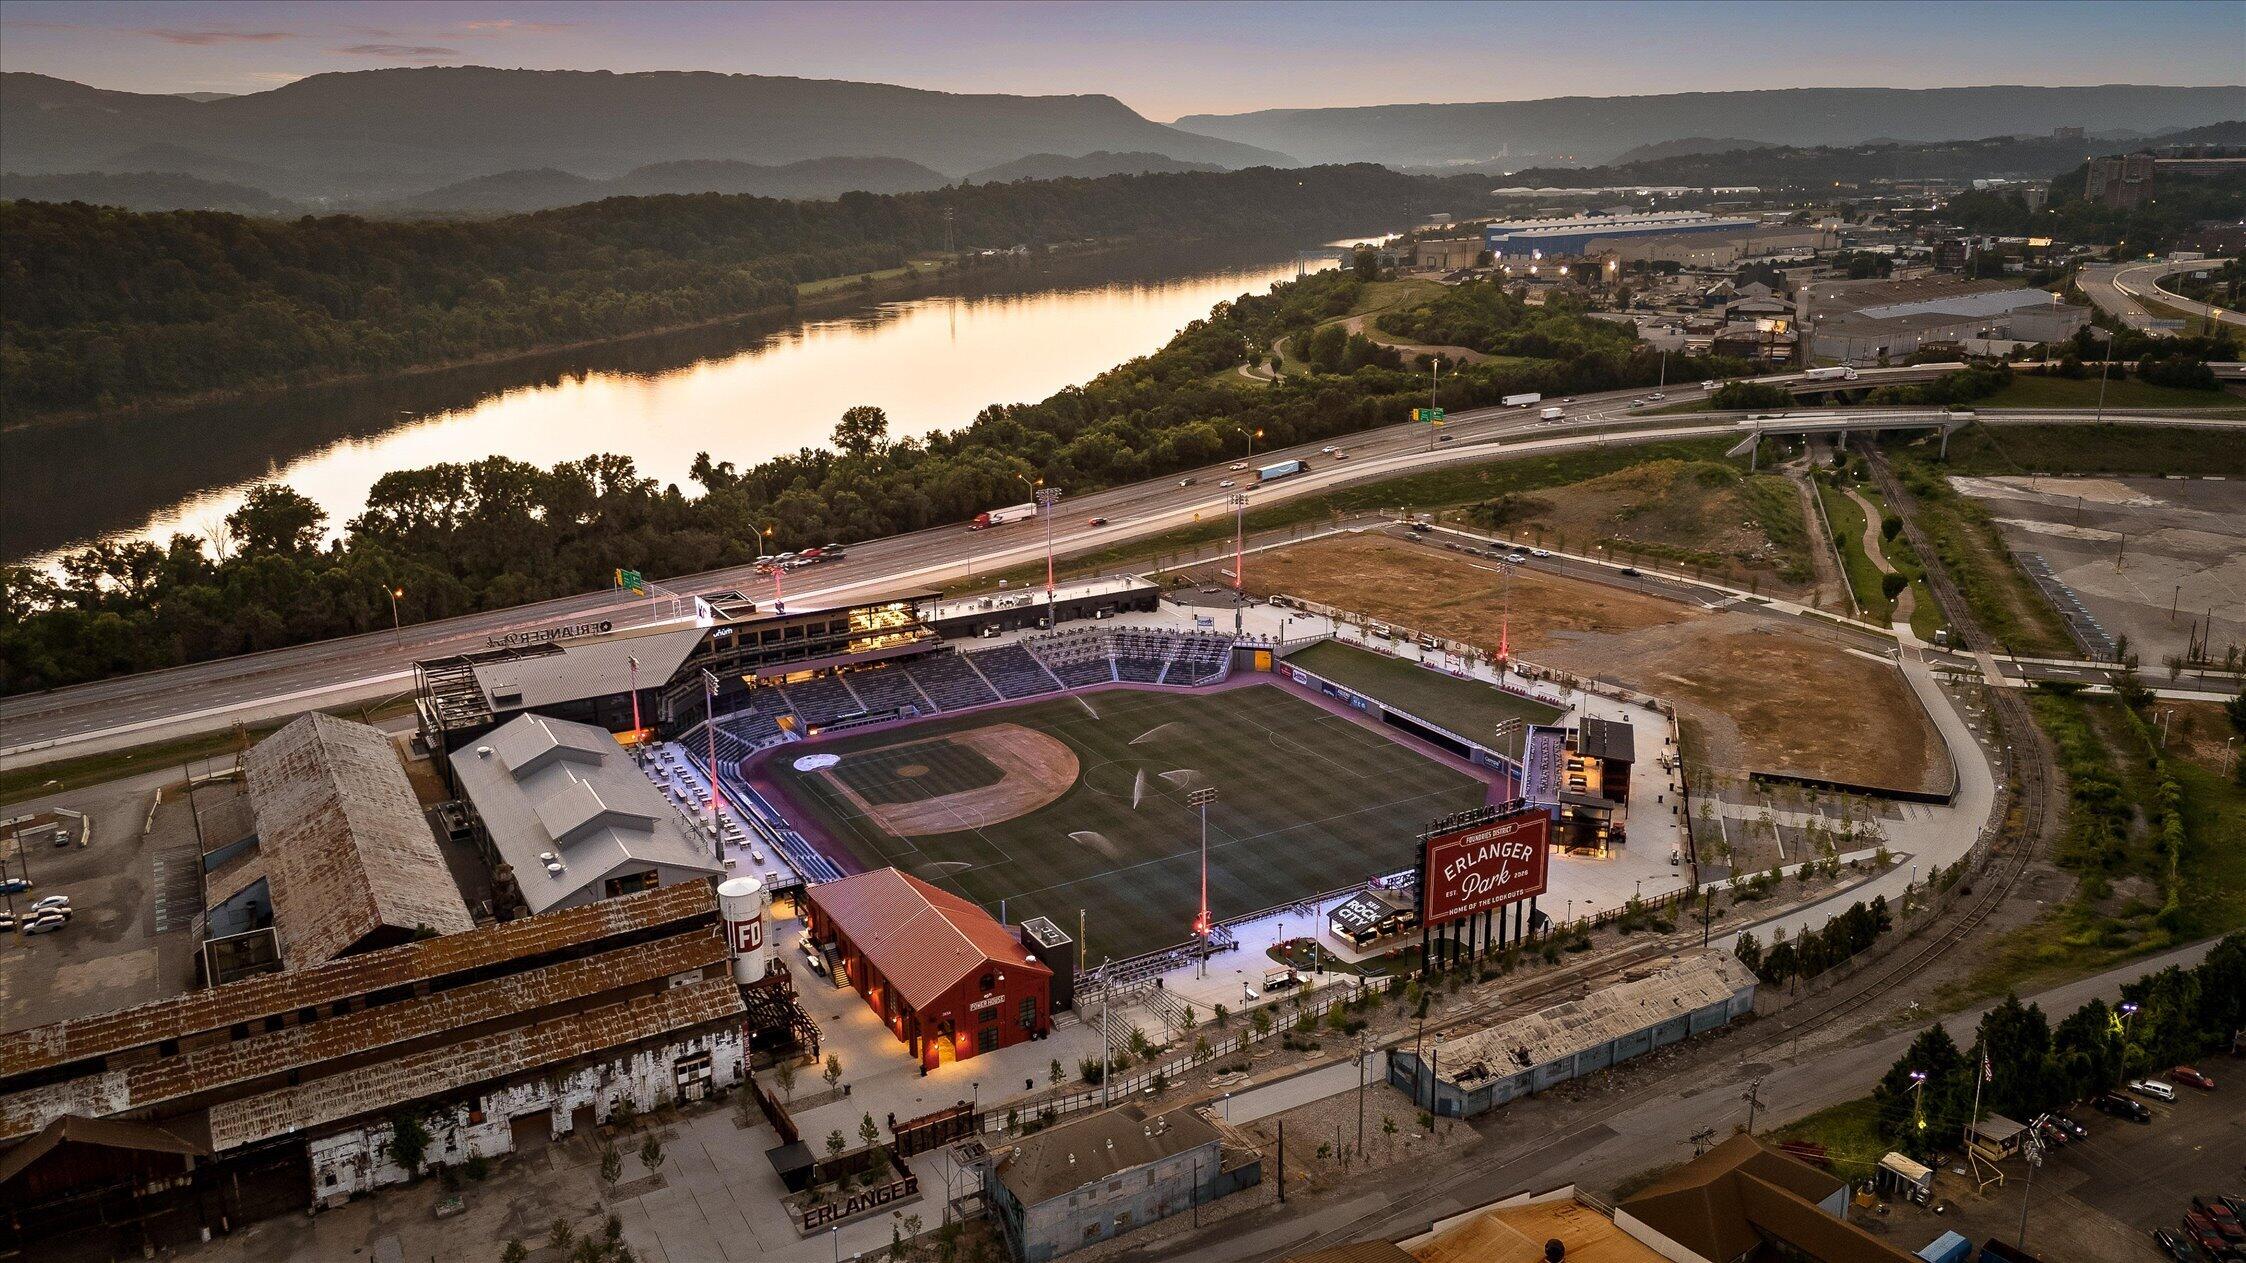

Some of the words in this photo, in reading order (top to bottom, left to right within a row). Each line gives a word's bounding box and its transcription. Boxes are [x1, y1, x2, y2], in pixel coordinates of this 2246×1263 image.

[1466, 831, 1491, 844] FOUNDRIES
[1492, 826, 1512, 837] DISTRICT
[1444, 842, 1533, 882] ERLANGER
[1445, 890, 1458, 898] EST.
[1461, 859, 1511, 901] Park
[1346, 899, 1382, 922] ROCK
[1449, 903, 1468, 916] HOME
[1468, 901, 1477, 911] OF
[1479, 898, 1491, 908] THE
[1491, 888, 1524, 905] LOOKOUTS
[1339, 909, 1369, 926] CITY
[738, 921, 761, 949] FD
[804, 1176, 919, 1230] ERLANGER
